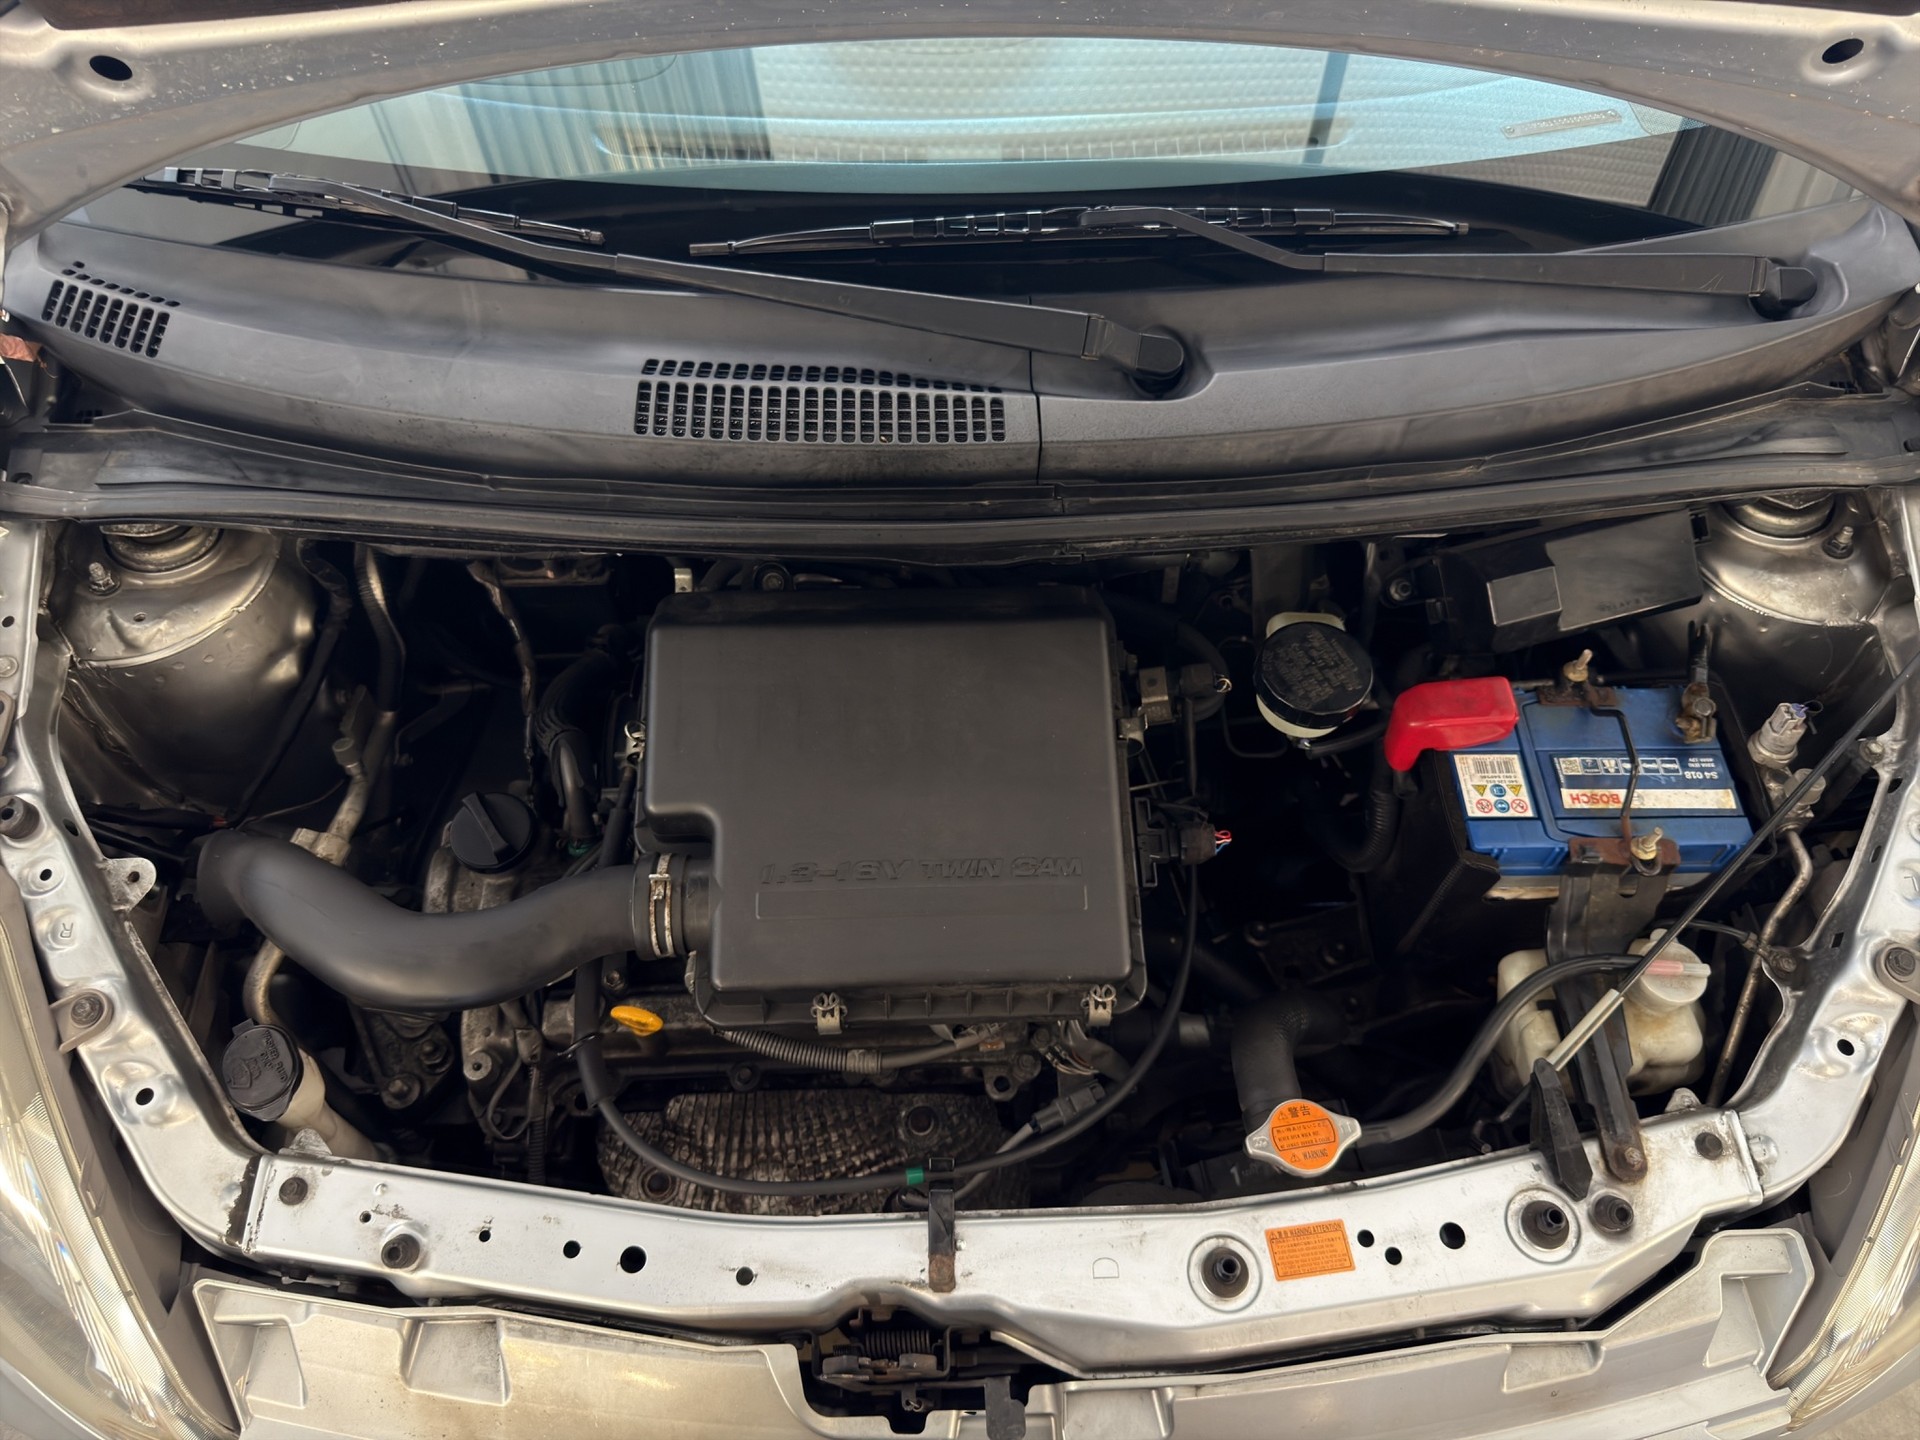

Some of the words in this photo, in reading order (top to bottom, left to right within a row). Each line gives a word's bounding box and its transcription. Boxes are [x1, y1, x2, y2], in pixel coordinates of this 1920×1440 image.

[1684, 770, 1703, 779] 018
[1704, 770, 1718, 779] S4
[1570, 792, 1622, 805] BOSCH
[919, 858, 1004, 880] TWIN
[1010, 856, 1083, 879] CAM
[60, 922, 73, 938] R
[1288, 1104, 1311, 1119] 警告
[1302, 1148, 1329, 1160] WARNING
[1312, 1222, 1342, 1234] ATTENTION
